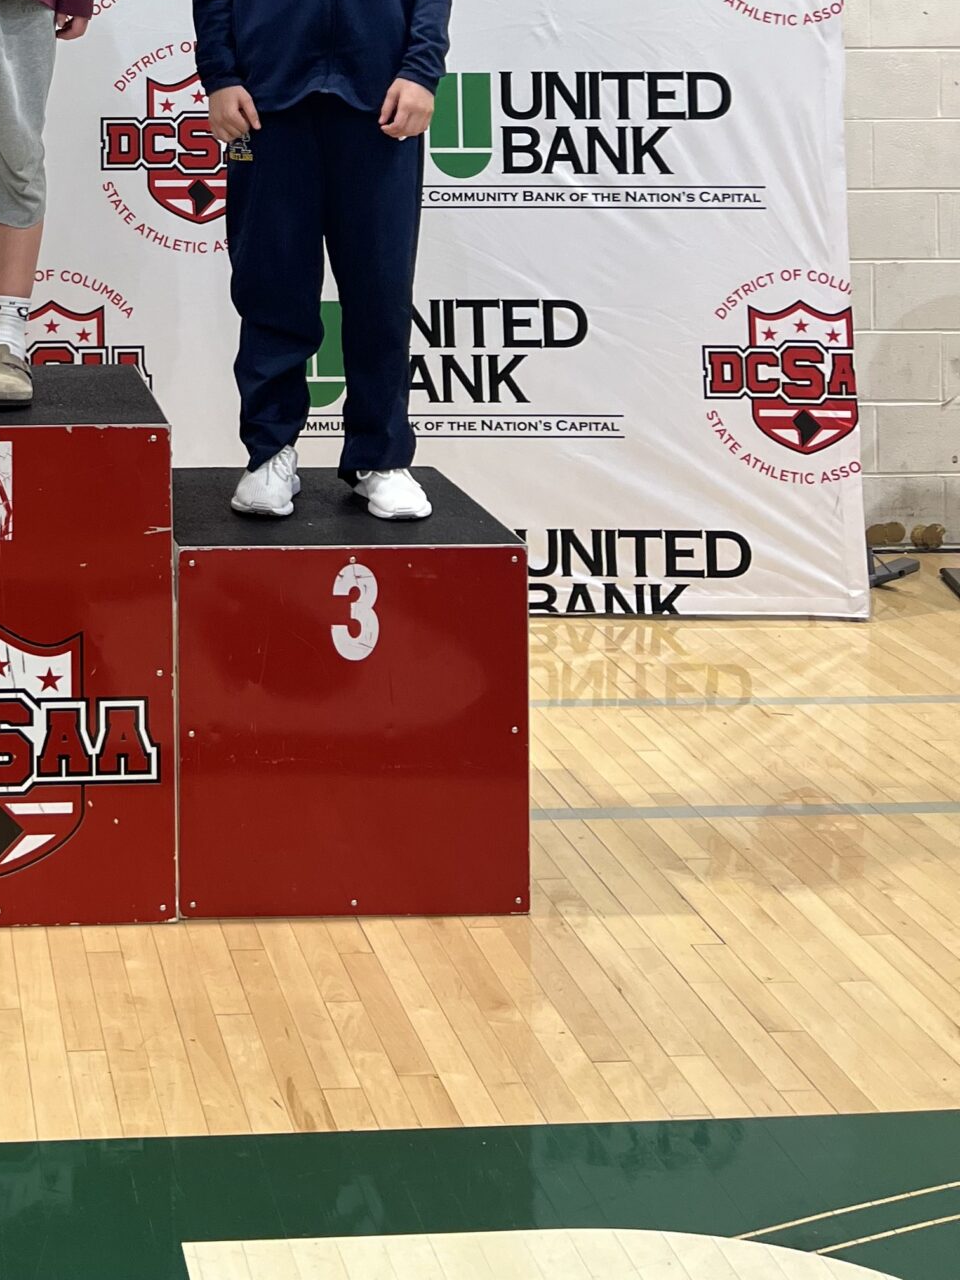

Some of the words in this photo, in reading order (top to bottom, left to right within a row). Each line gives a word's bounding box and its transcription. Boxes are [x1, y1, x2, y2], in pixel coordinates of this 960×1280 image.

[114, 45, 174, 92] DISTRICT
[499, 71, 732, 120] UNITED
[501, 126, 674, 175] BANK
[103, 181, 136, 224] STATE
[135, 223, 207, 255] ATHLETIC
[34, 270, 54, 281] OF
[60, 270, 134, 318] COLUMBIA
[714, 272, 775, 320] DISTRICT
[779, 268, 801, 282] OF
[706, 410, 742, 454] STATE
[741, 453, 813, 485] ATHLETIC
[515, 529, 751, 579] UNITED
[330, 563, 380, 661] 3
